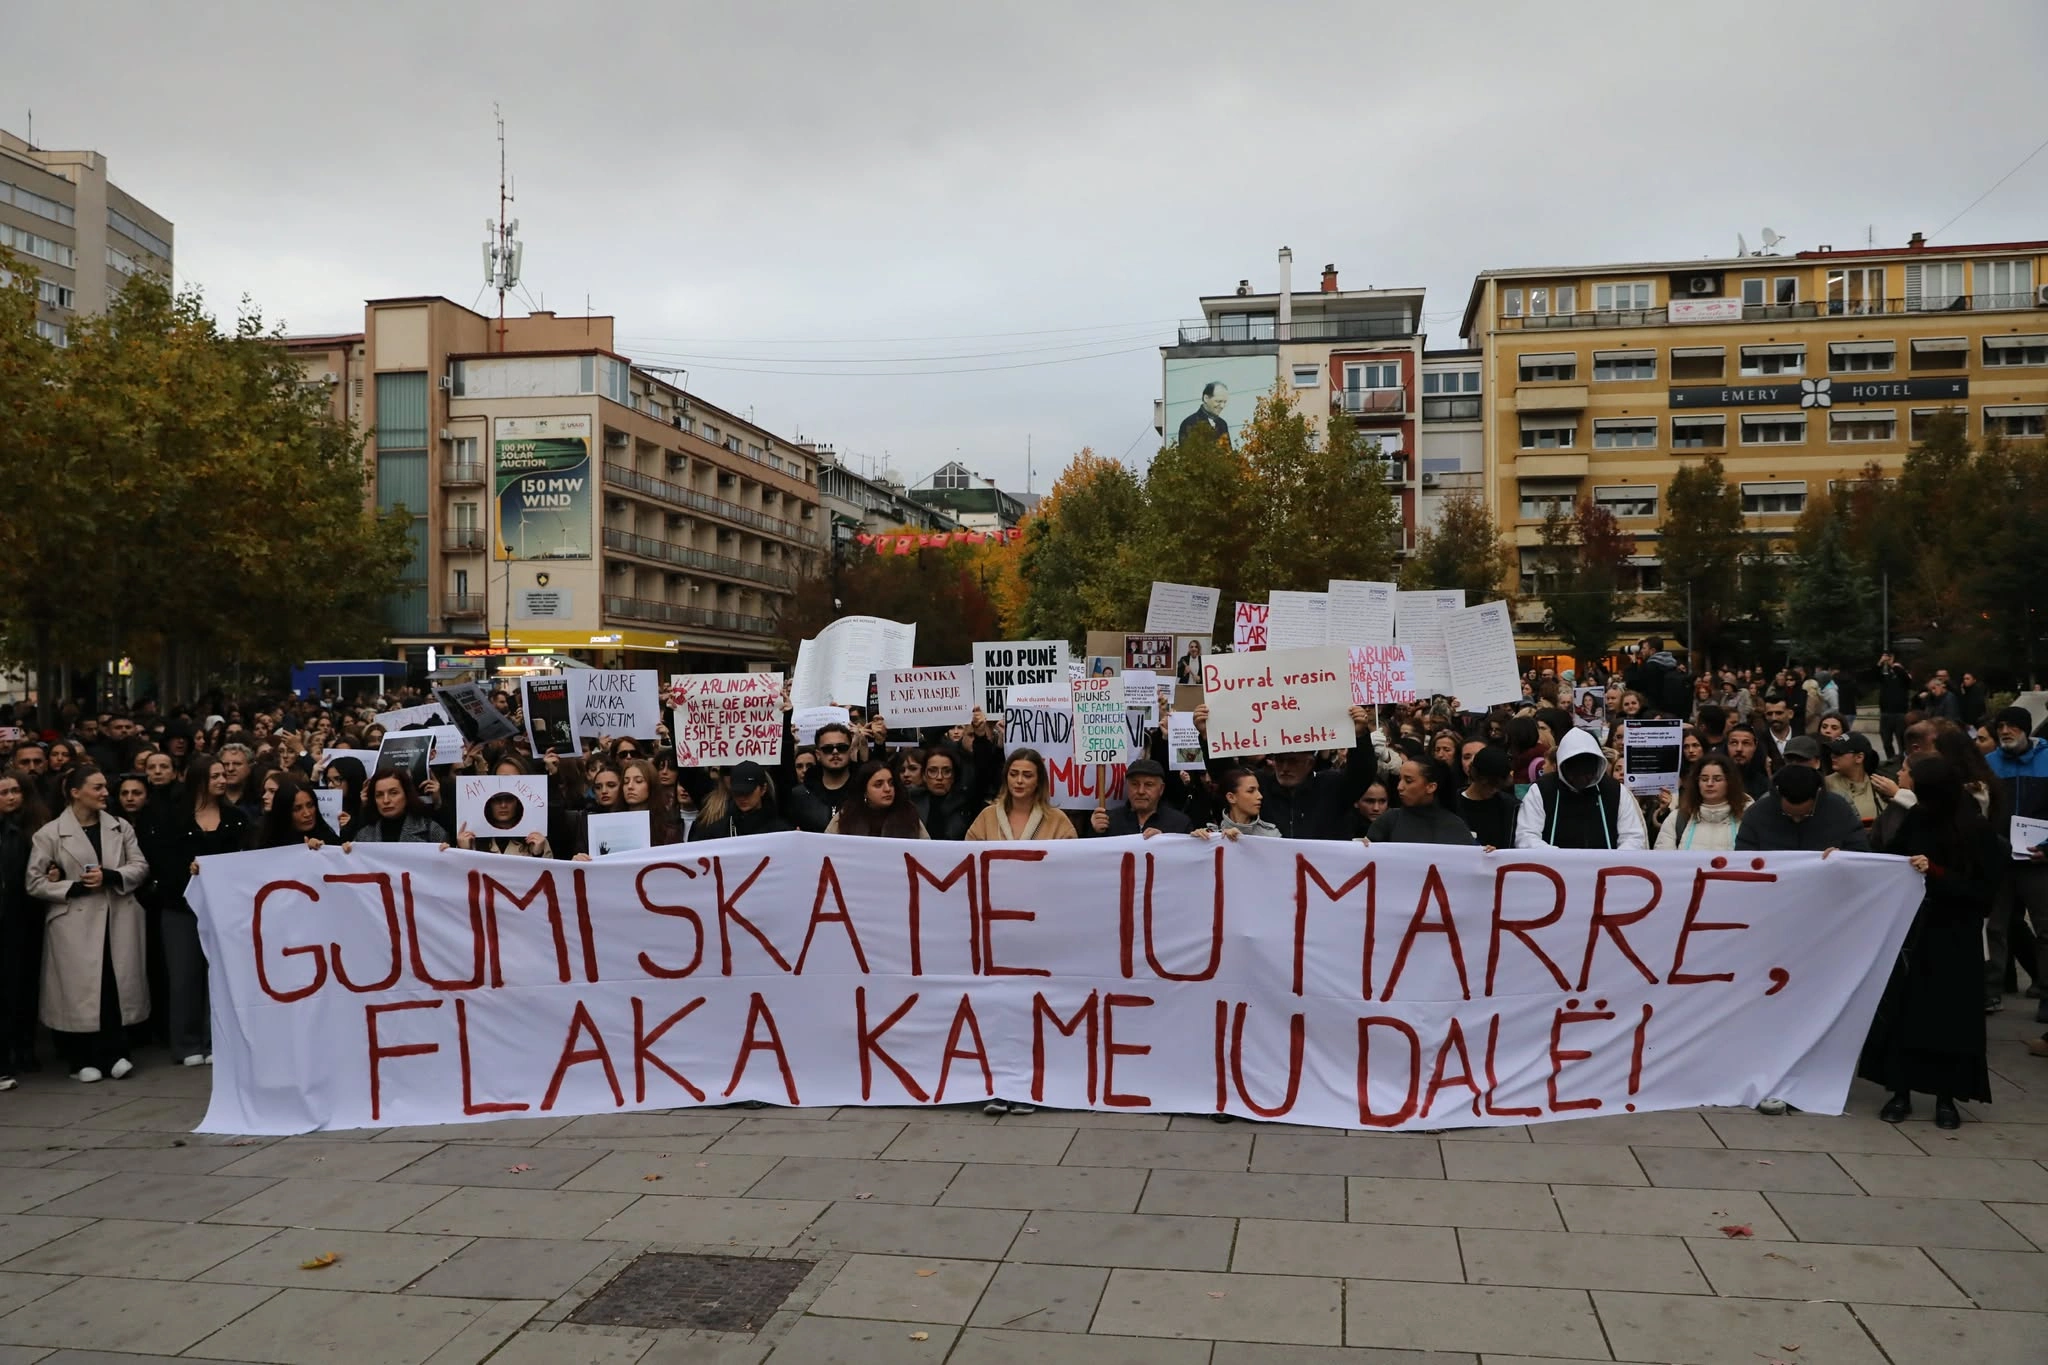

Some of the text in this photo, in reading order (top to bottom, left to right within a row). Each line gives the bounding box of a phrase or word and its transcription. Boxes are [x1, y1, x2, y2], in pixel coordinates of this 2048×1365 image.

[1721, 384, 1912, 402] EMERY HOTEL
[501, 442, 536, 452] 100 MW
[500, 459, 547, 468] AUCTION
[501, 451, 534, 460] SOLAR
[522, 478, 584, 493] 150 MW
[522, 493, 571, 507] WIND
[985, 645, 1057, 667] KJO PUNË
[1358, 646, 1406, 663] ARLINDA
[894, 671, 956, 684] KRONIKA
[985, 670, 1014, 686] NUK
[1017, 669, 1057, 685] OSHT'
[1073, 679, 1109, 691] STOP
[1204, 665, 1336, 693] Burrat vrasin
[701, 678, 757, 694] ARLINDA
[890, 690, 896, 701] E
[899, 686, 916, 702] NJË
[917, 686, 960, 700] VRASJEJE
[585, 694, 625, 709] NUK KA
[687, 701, 699, 712] NA
[702, 700, 719, 710] FAL
[744, 694, 775, 708] BOTA
[985, 689, 1008, 713] HA
[1074, 690, 1110, 702] DHUNES
[1077, 703, 1089, 713] NE
[581, 712, 635, 728] ARSYETIM
[719, 710, 746, 725] ENDE
[751, 709, 775, 722] NUK
[729, 725, 736, 739] E
[1088, 725, 1124, 735] DONIKA
[1212, 729, 1267, 753] shteti
[1281, 726, 1337, 746] heshtë
[1084, 750, 1117, 762] STOP
[466, 779, 486, 800] AM
[514, 780, 545, 808] NEXT?
[253, 846, 1789, 1002] GJUMI S'KA ME IU MARRË,
[365, 986, 1652, 1127] FLAKA KA ME IU DALË!
